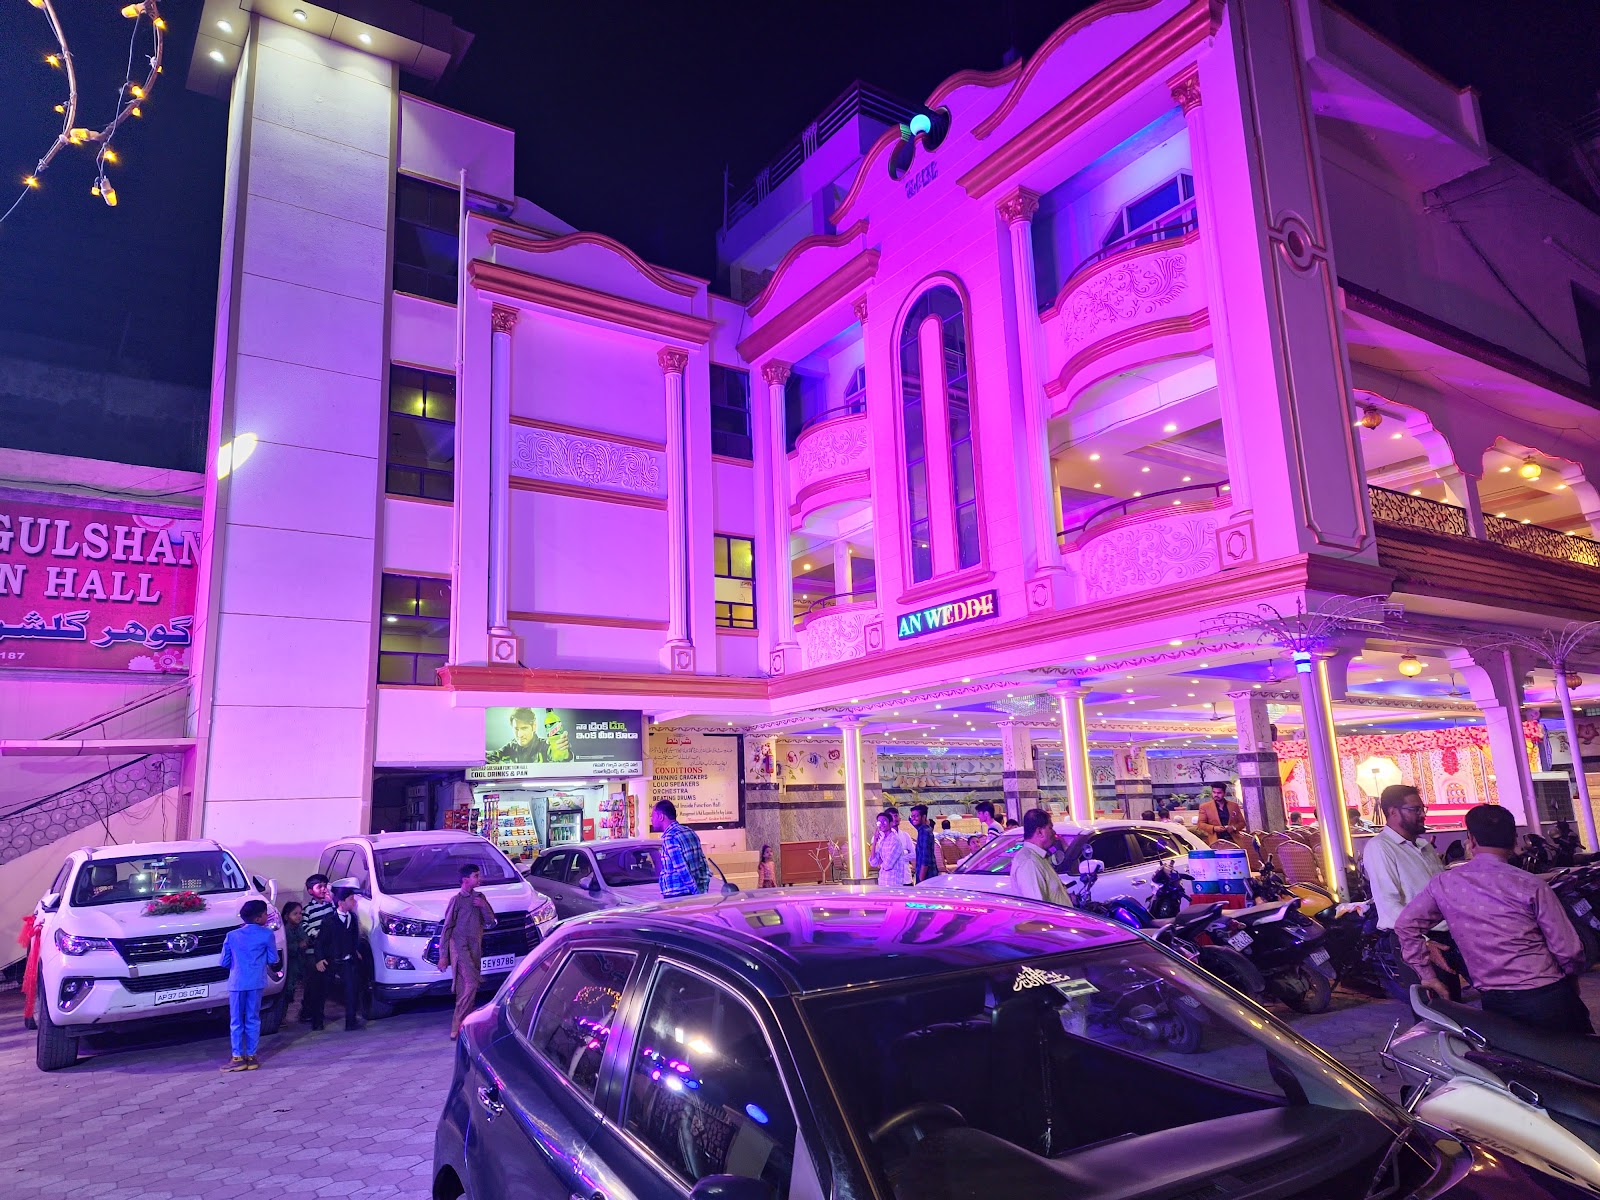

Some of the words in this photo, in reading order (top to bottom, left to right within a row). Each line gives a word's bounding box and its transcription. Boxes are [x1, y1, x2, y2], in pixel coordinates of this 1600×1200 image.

[44, 566, 161, 603] HALL
[898, 613, 922, 637] AN
[487, 770, 509, 778] DRINKS
